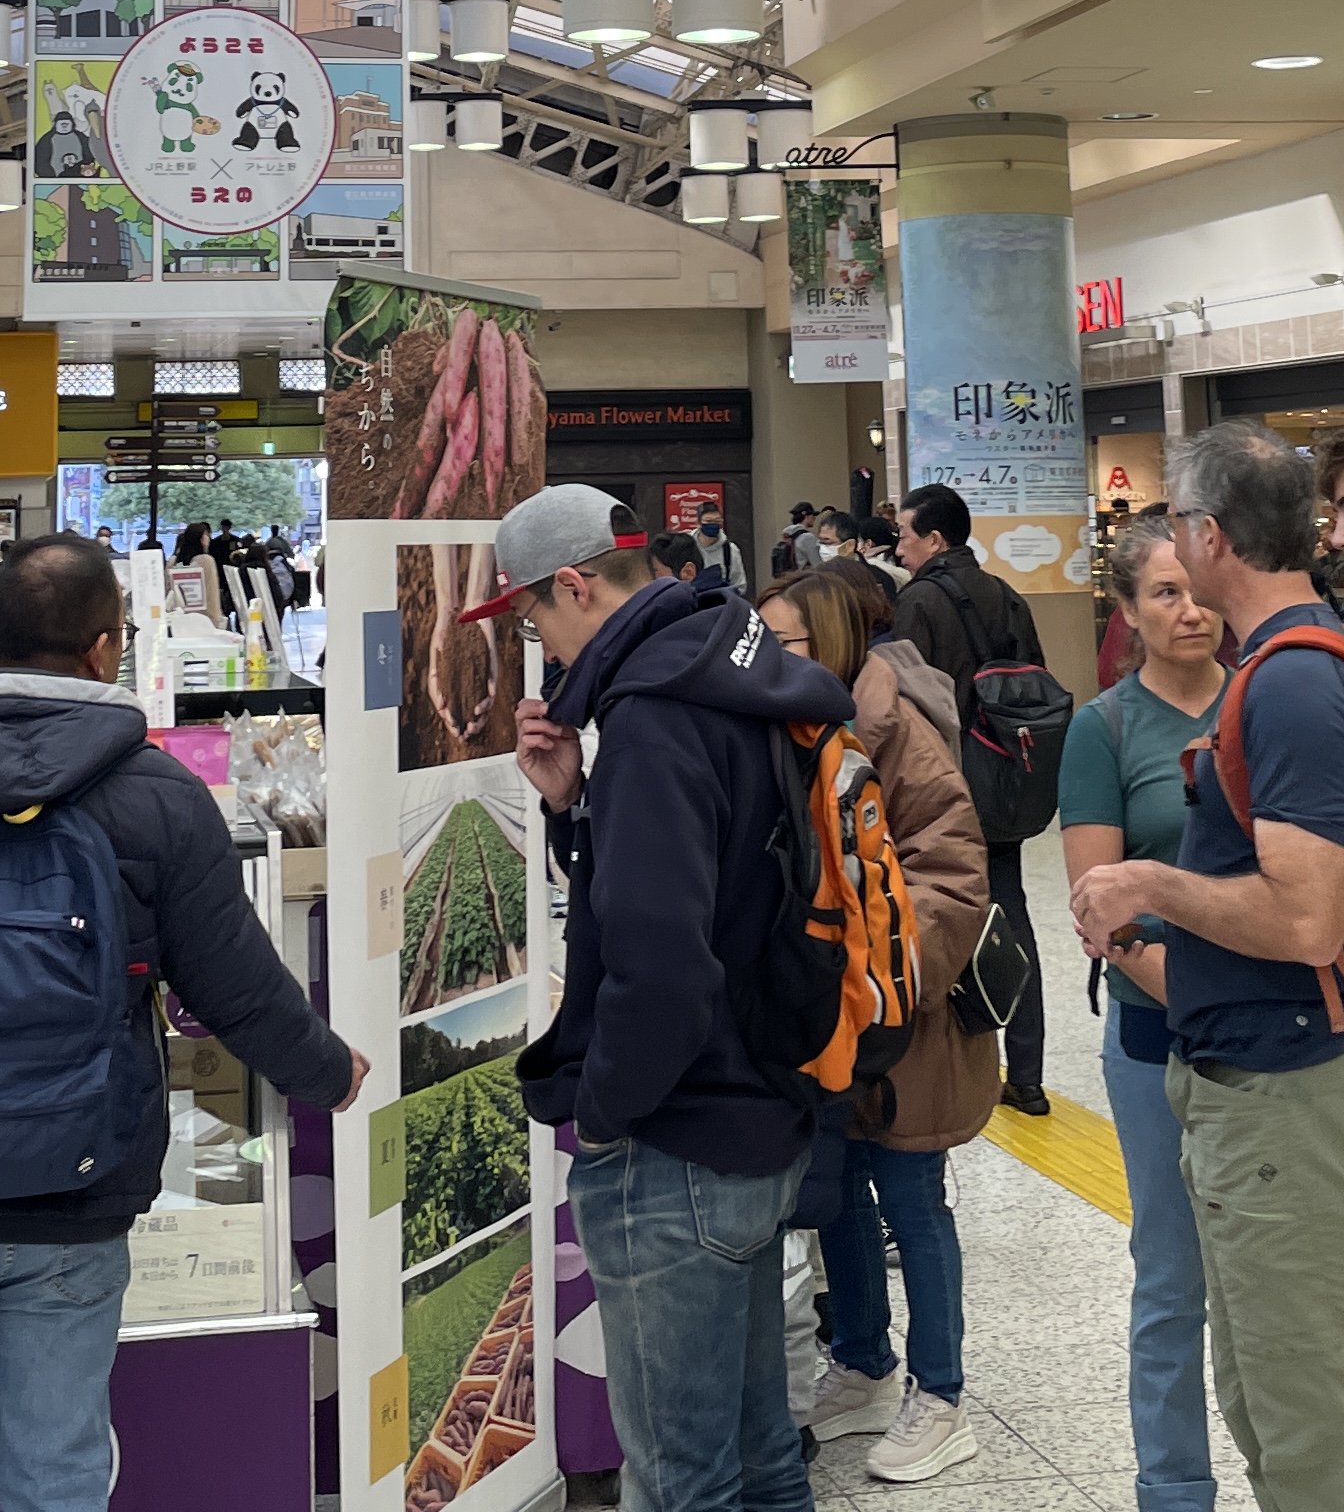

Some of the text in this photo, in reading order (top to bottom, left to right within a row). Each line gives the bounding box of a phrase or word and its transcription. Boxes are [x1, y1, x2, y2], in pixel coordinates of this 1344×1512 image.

[178, 36, 266, 55] ようこそ
[785, 142, 850, 165] atre
[145, 161, 198, 173] JR上野駅
[244, 161, 298, 173] アトレ上野
[190, 186, 253, 204] うえの
[806, 287, 870, 308] 印象派
[825, 351, 858, 368] atré
[953, 380, 1075, 425] 印象派
[600, 406, 662, 425] Flower
[666, 405, 731, 423] Market
